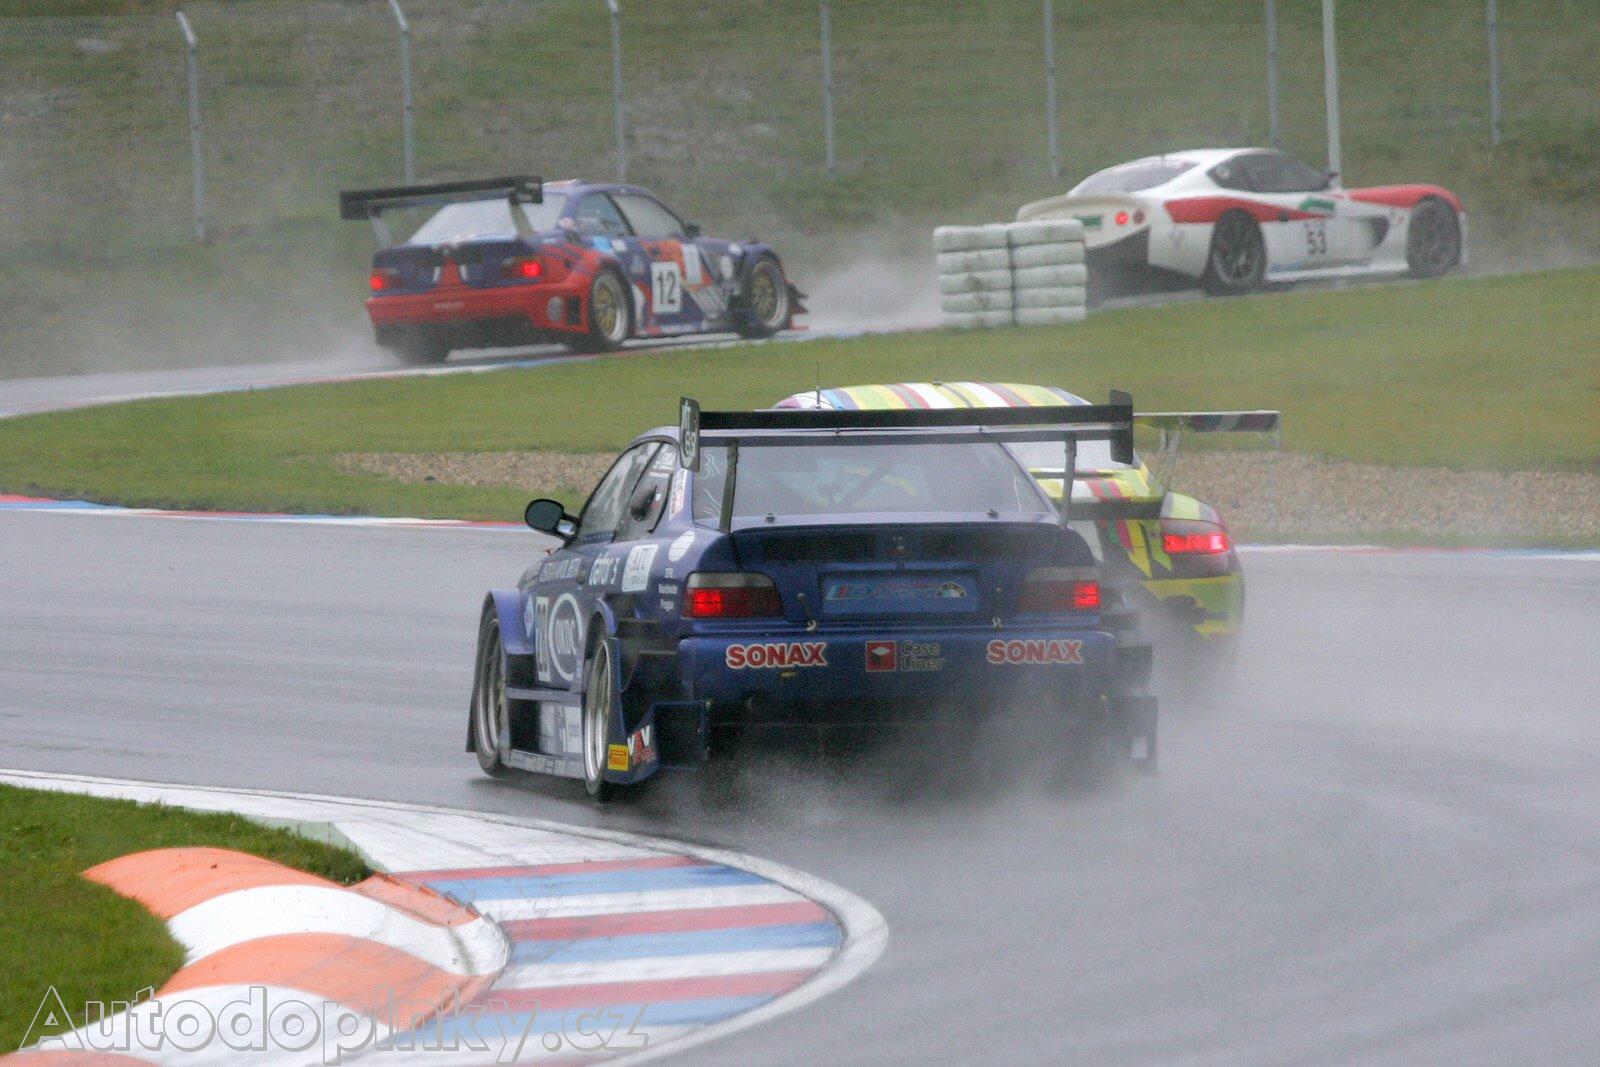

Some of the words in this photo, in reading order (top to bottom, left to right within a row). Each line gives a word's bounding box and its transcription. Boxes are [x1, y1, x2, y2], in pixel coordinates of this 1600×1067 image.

[1307, 229, 1327, 255] 53
[656, 269, 677, 305] 12
[726, 641, 828, 669] SONAX
[900, 640, 942, 657] Case
[986, 639, 1084, 664] SONAX
[900, 657, 946, 673] Liner
